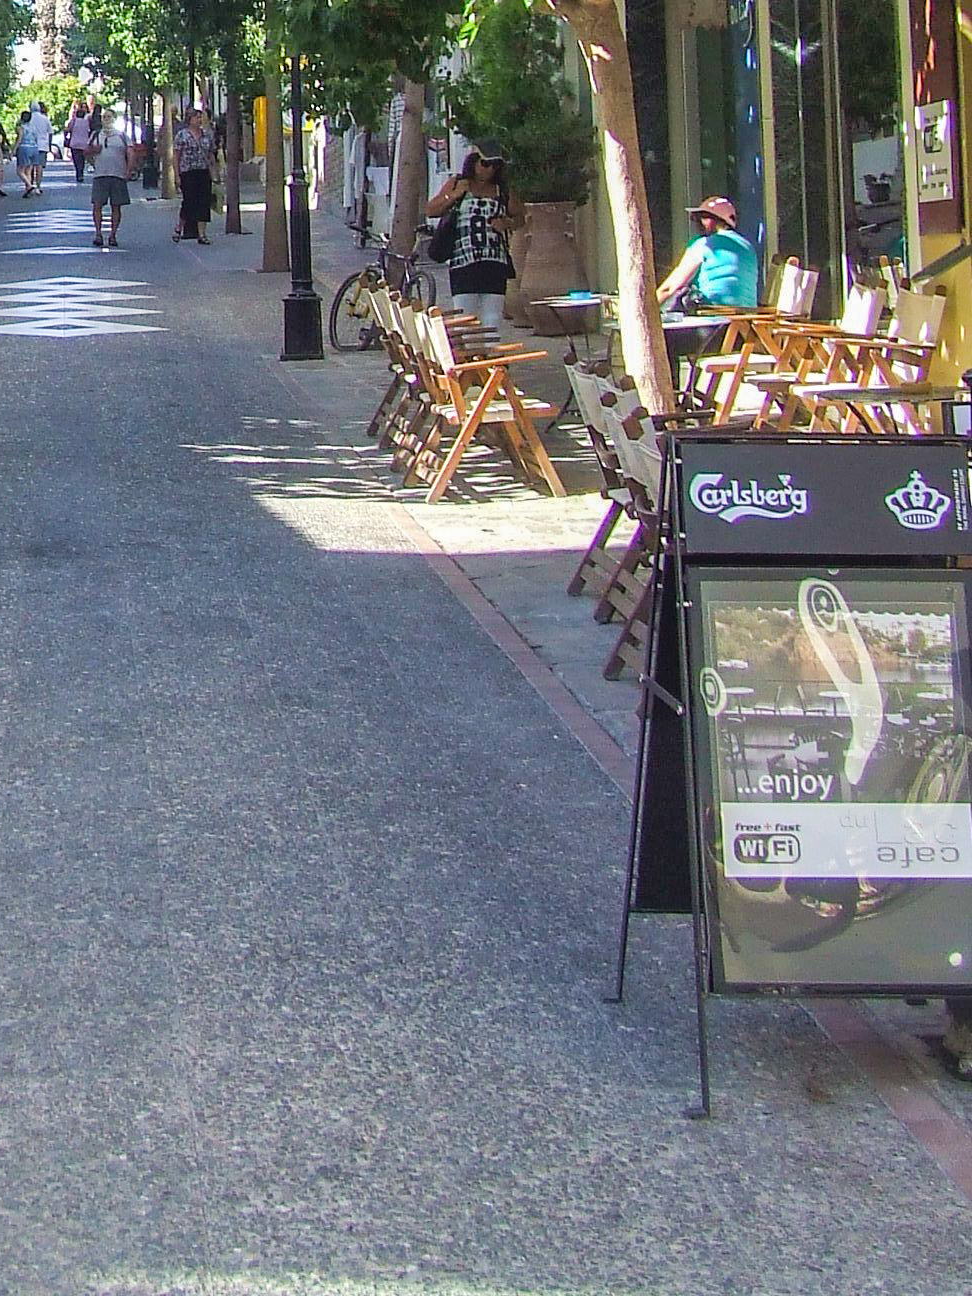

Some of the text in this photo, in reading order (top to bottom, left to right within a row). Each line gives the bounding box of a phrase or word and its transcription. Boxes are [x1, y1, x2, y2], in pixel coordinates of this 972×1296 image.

[689, 473, 808, 520] Carlsberg
[736, 768, 833, 801] ...enjoy
[735, 822, 762, 831] free
[775, 822, 802, 831] fast
[877, 846, 960, 868] cafe
